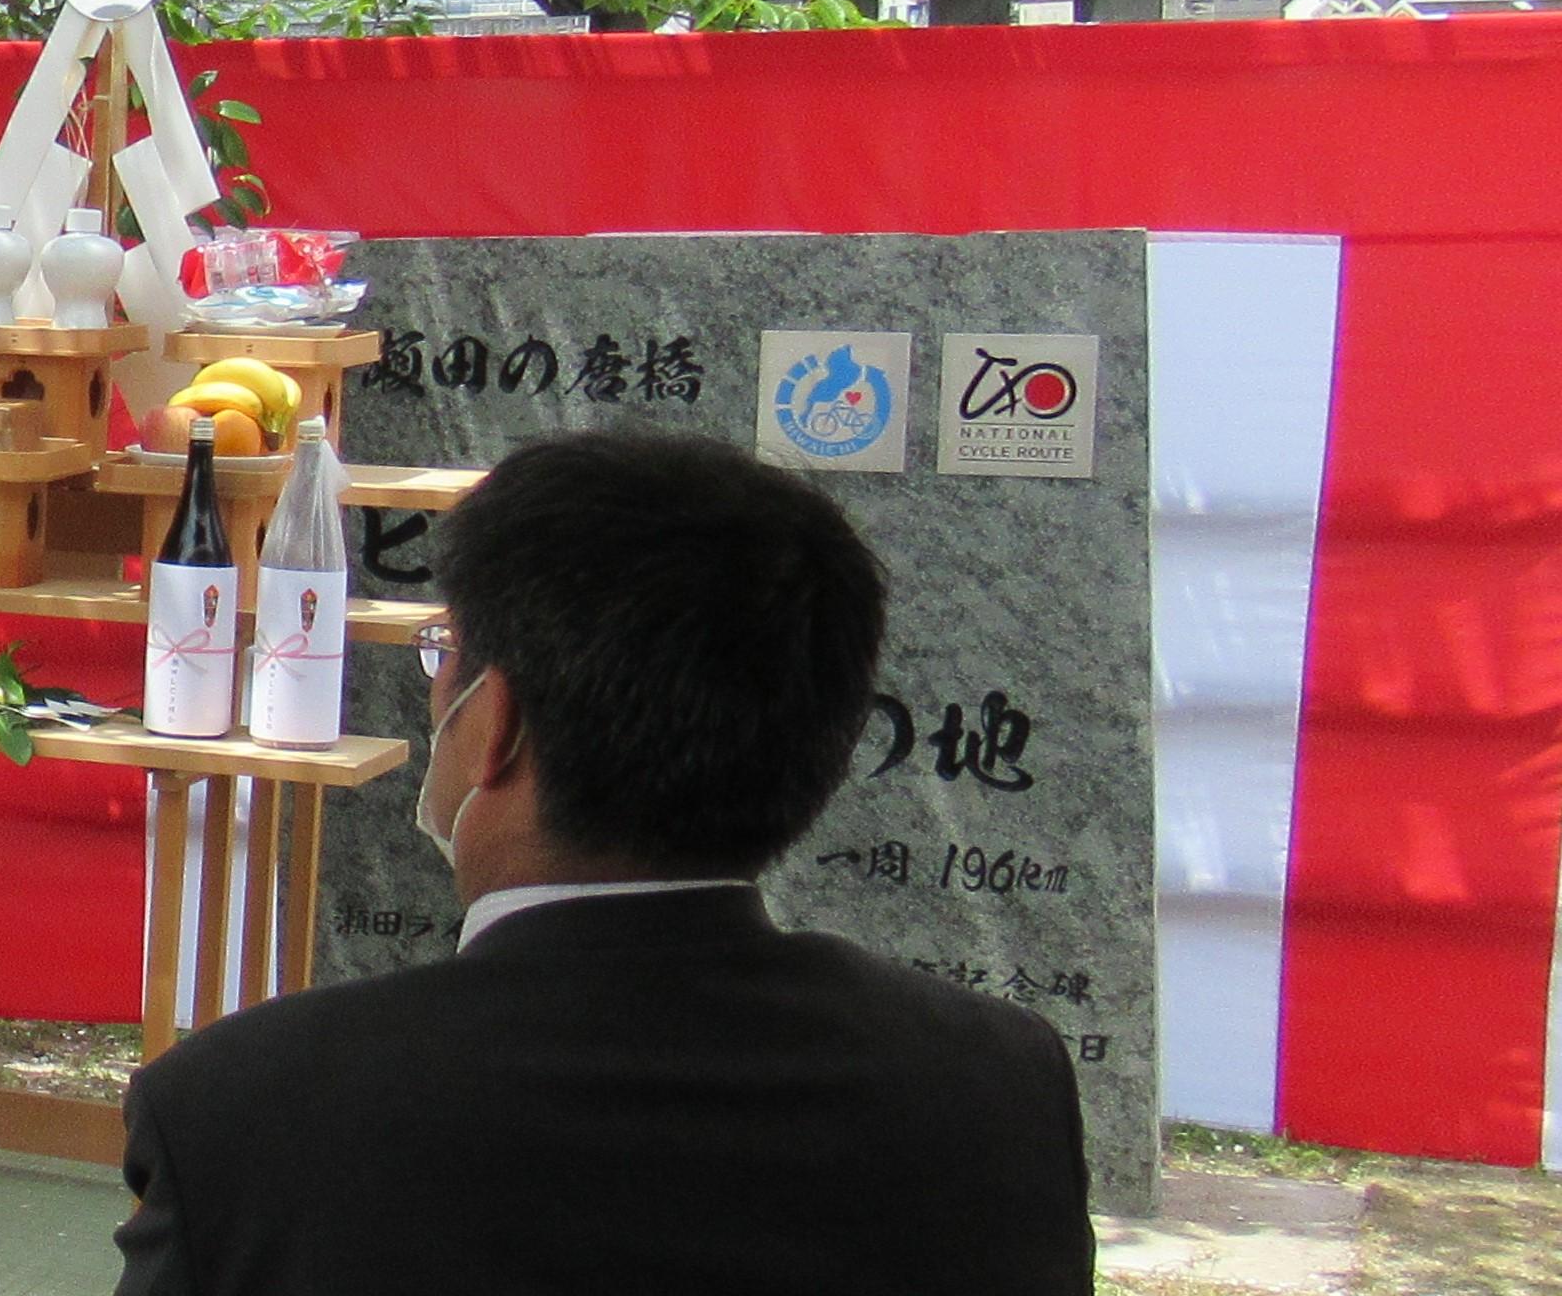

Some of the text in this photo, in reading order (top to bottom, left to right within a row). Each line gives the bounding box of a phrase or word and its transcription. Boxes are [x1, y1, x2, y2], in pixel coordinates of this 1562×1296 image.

[361, 330, 705, 404] 瀬田の唐橋
[960, 426, 1072, 442] NATIONAL
[958, 446, 1073, 460] CYCLE ROUTE
[816, 840, 1069, 895] 一周 196km
